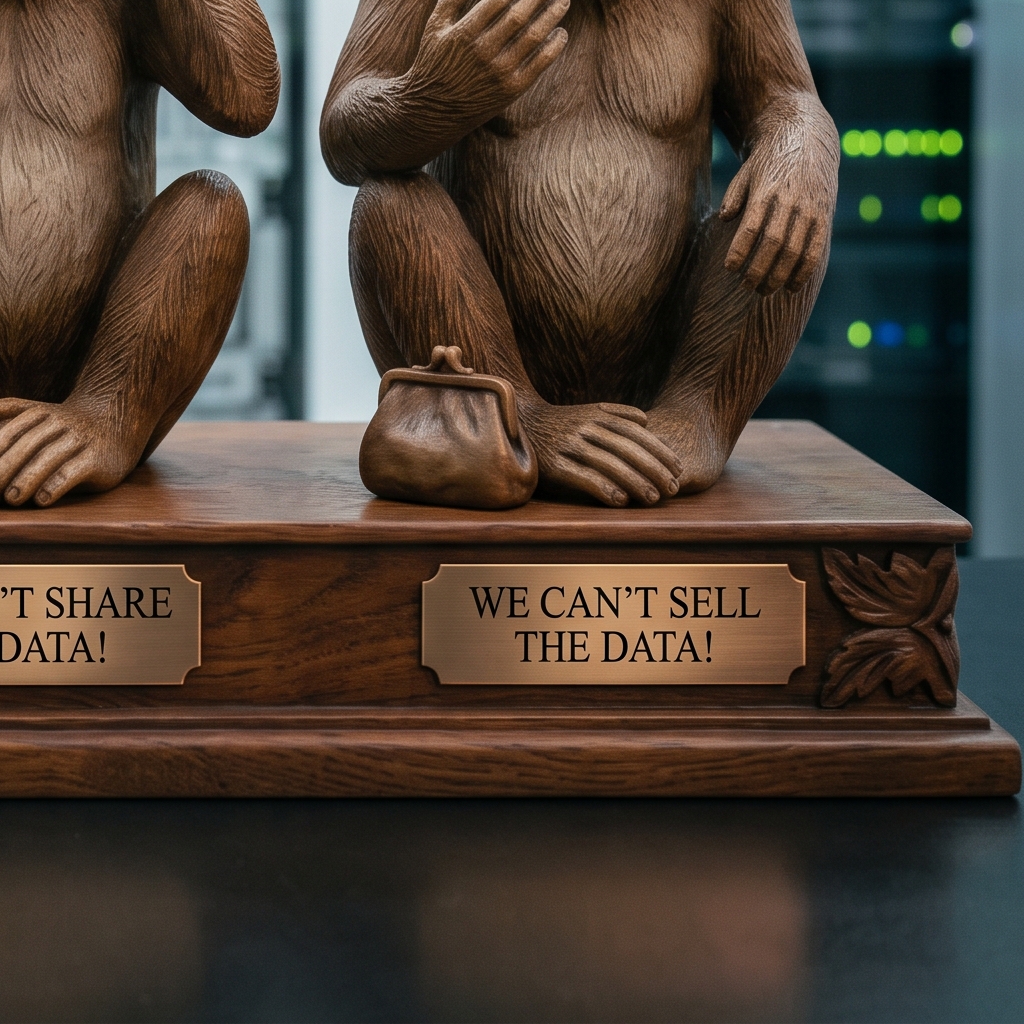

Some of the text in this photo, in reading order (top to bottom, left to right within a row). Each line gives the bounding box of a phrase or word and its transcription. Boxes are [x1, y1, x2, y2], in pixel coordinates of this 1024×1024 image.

[45, 586, 173, 619] SHARE
[468, 586, 762, 619] WE CAN’T SELL
[514, 631, 712, 663] THE DATA!
